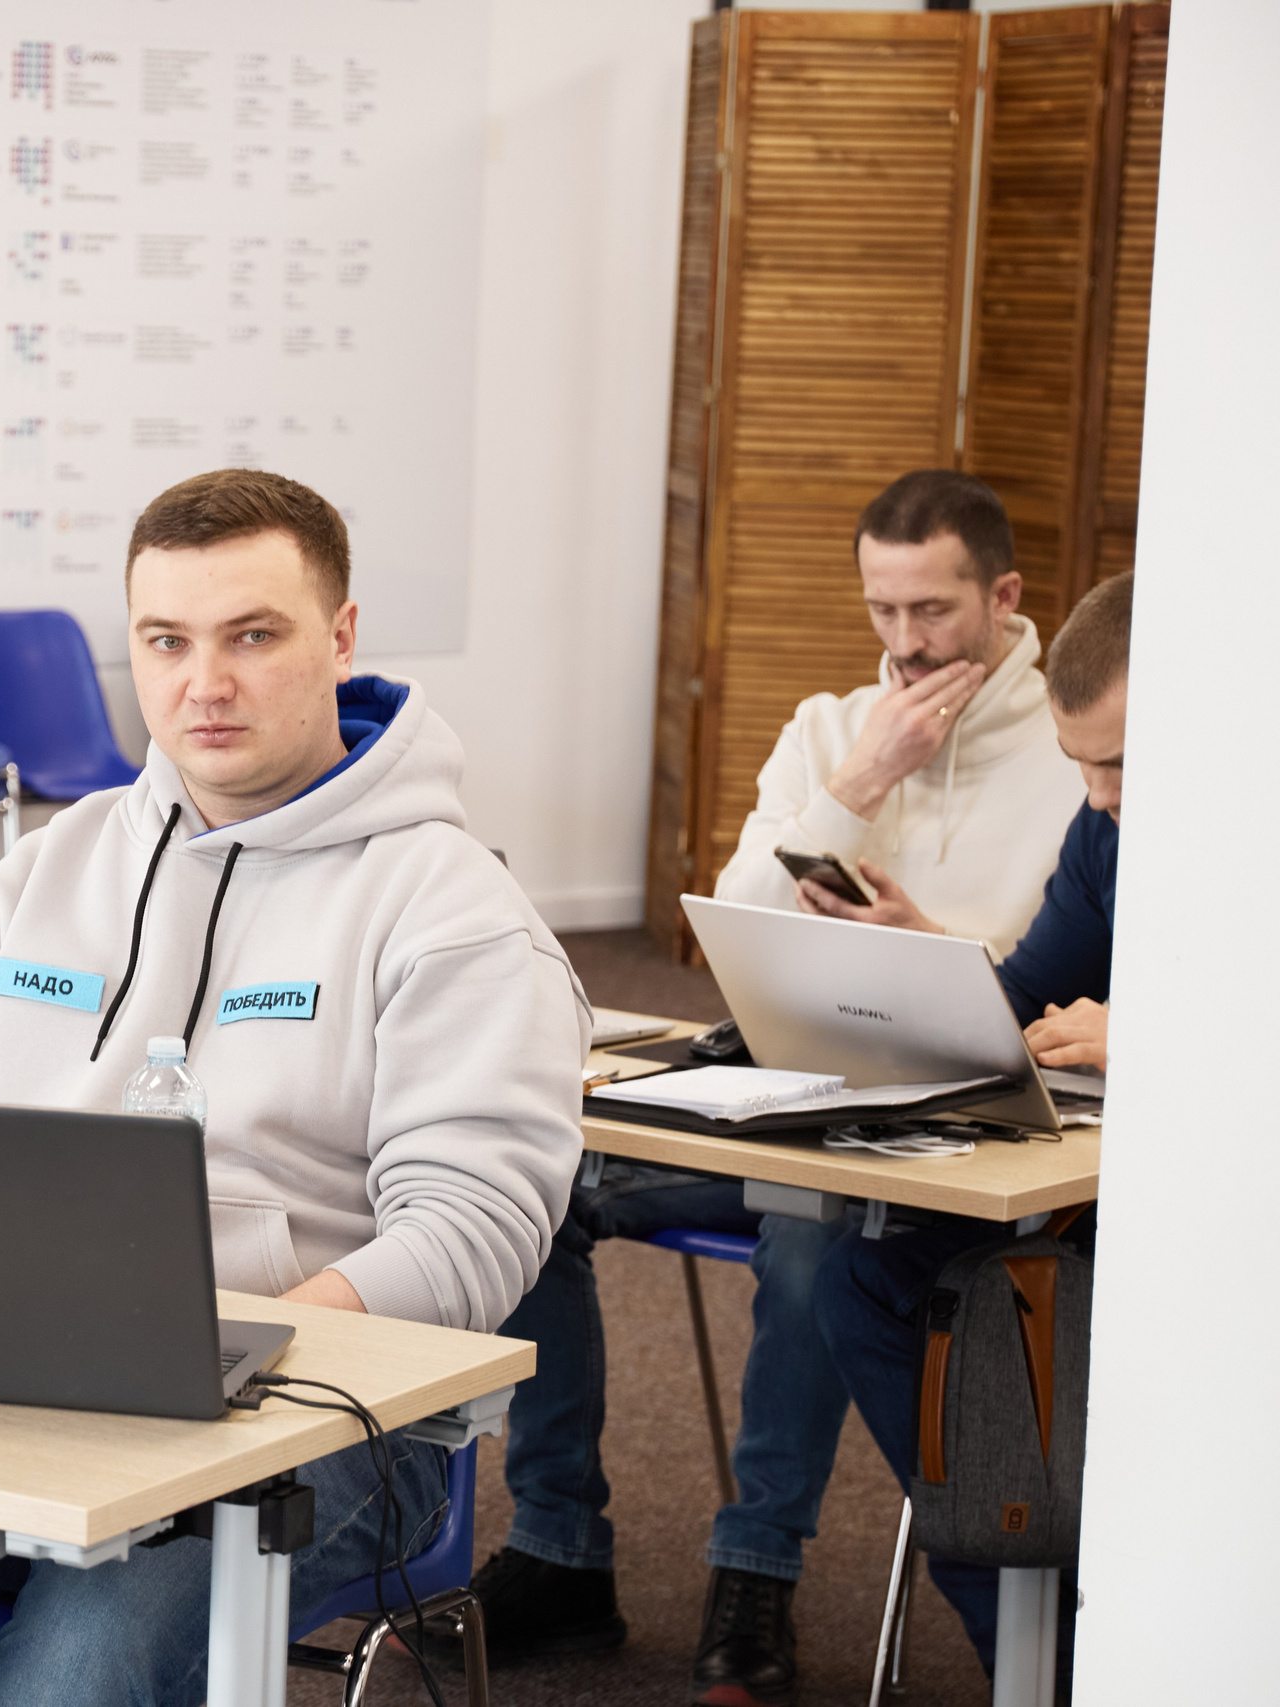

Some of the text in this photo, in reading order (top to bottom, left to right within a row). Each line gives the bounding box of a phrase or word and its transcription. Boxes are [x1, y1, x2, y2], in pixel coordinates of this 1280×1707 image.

[13, 970, 74, 996] НАДО
[222, 991, 307, 1013] ПОБЕДИТЬ
[837, 1004, 892, 1021] HUAWEI
